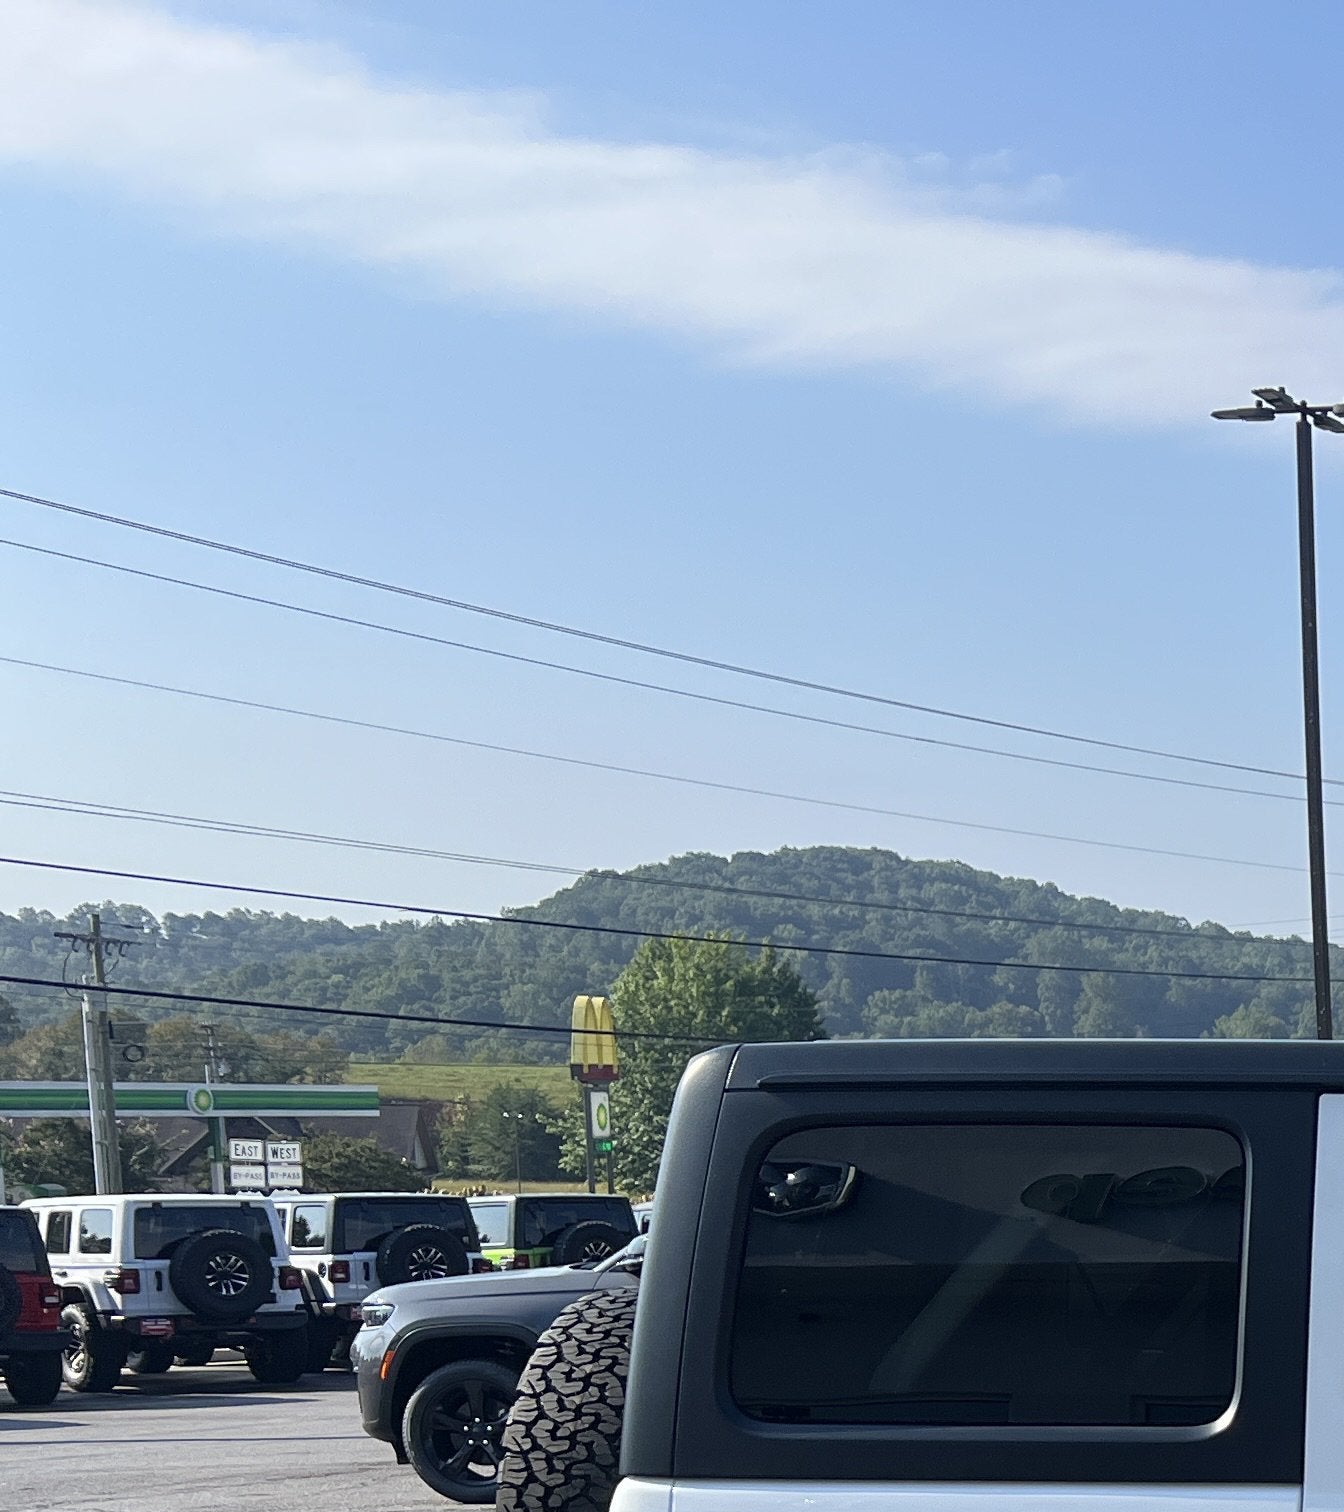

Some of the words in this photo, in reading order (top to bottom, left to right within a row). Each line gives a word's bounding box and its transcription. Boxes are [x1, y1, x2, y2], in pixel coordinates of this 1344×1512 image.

[234, 1144, 258, 1157] EAST
[271, 1146, 296, 1159] WEST
[234, 1172, 262, 1180] BY-PASS
[270, 1171, 300, 1180] BY-PASS
